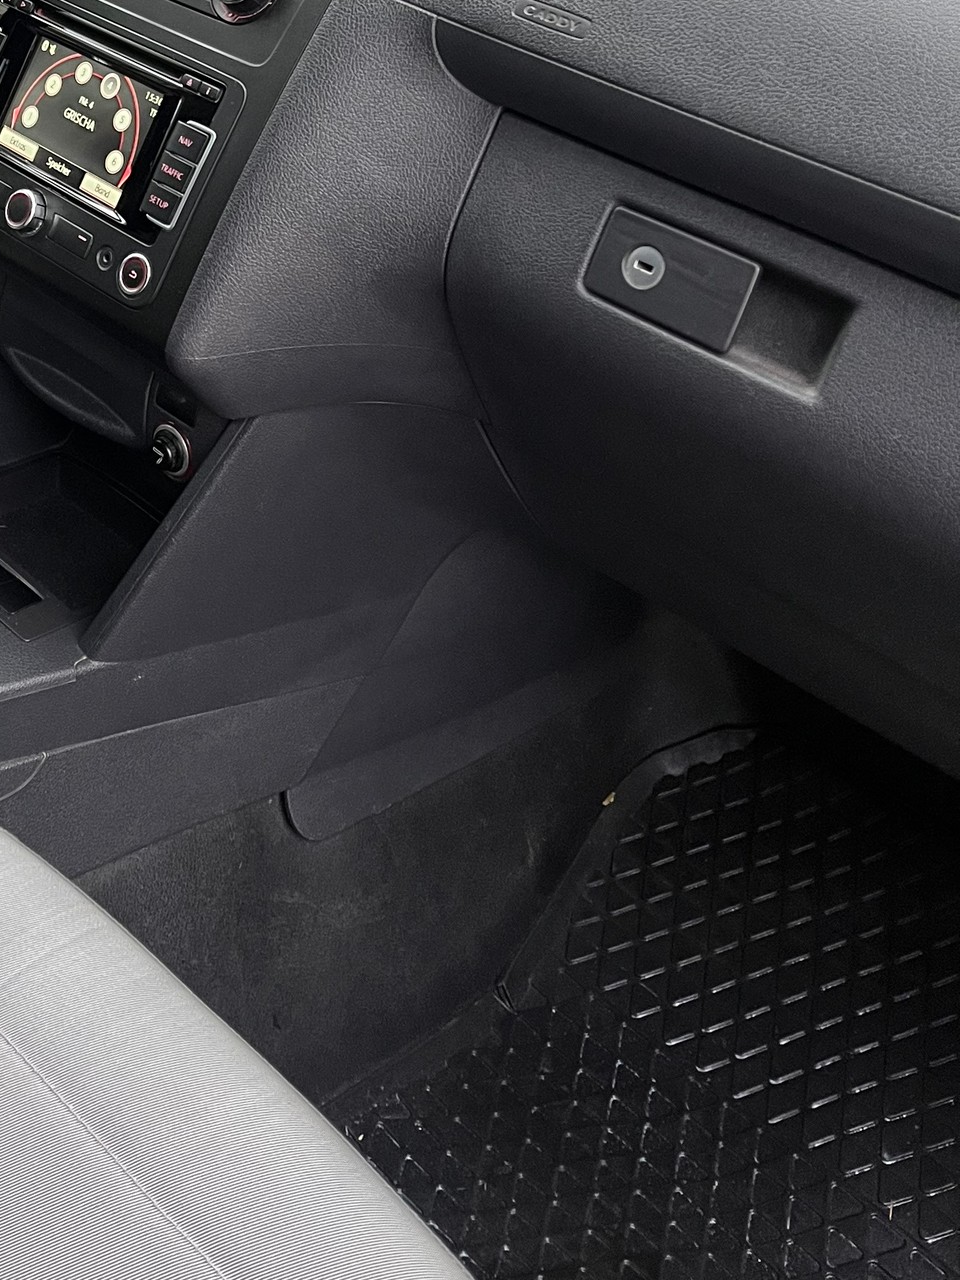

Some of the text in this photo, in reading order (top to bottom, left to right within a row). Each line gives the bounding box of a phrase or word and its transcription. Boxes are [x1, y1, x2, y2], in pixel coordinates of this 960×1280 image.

[523, 5, 582, 32] CADDY
[63, 107, 96, 132] GRISCHA
[9, 136, 26, 152] Extras
[178, 135, 193, 148] NAV
[45, 156, 71, 177] Speicher
[160, 163, 184, 181] TRAFFIC
[94, 183, 110, 199] Band
[148, 194, 169, 209] SETUP
